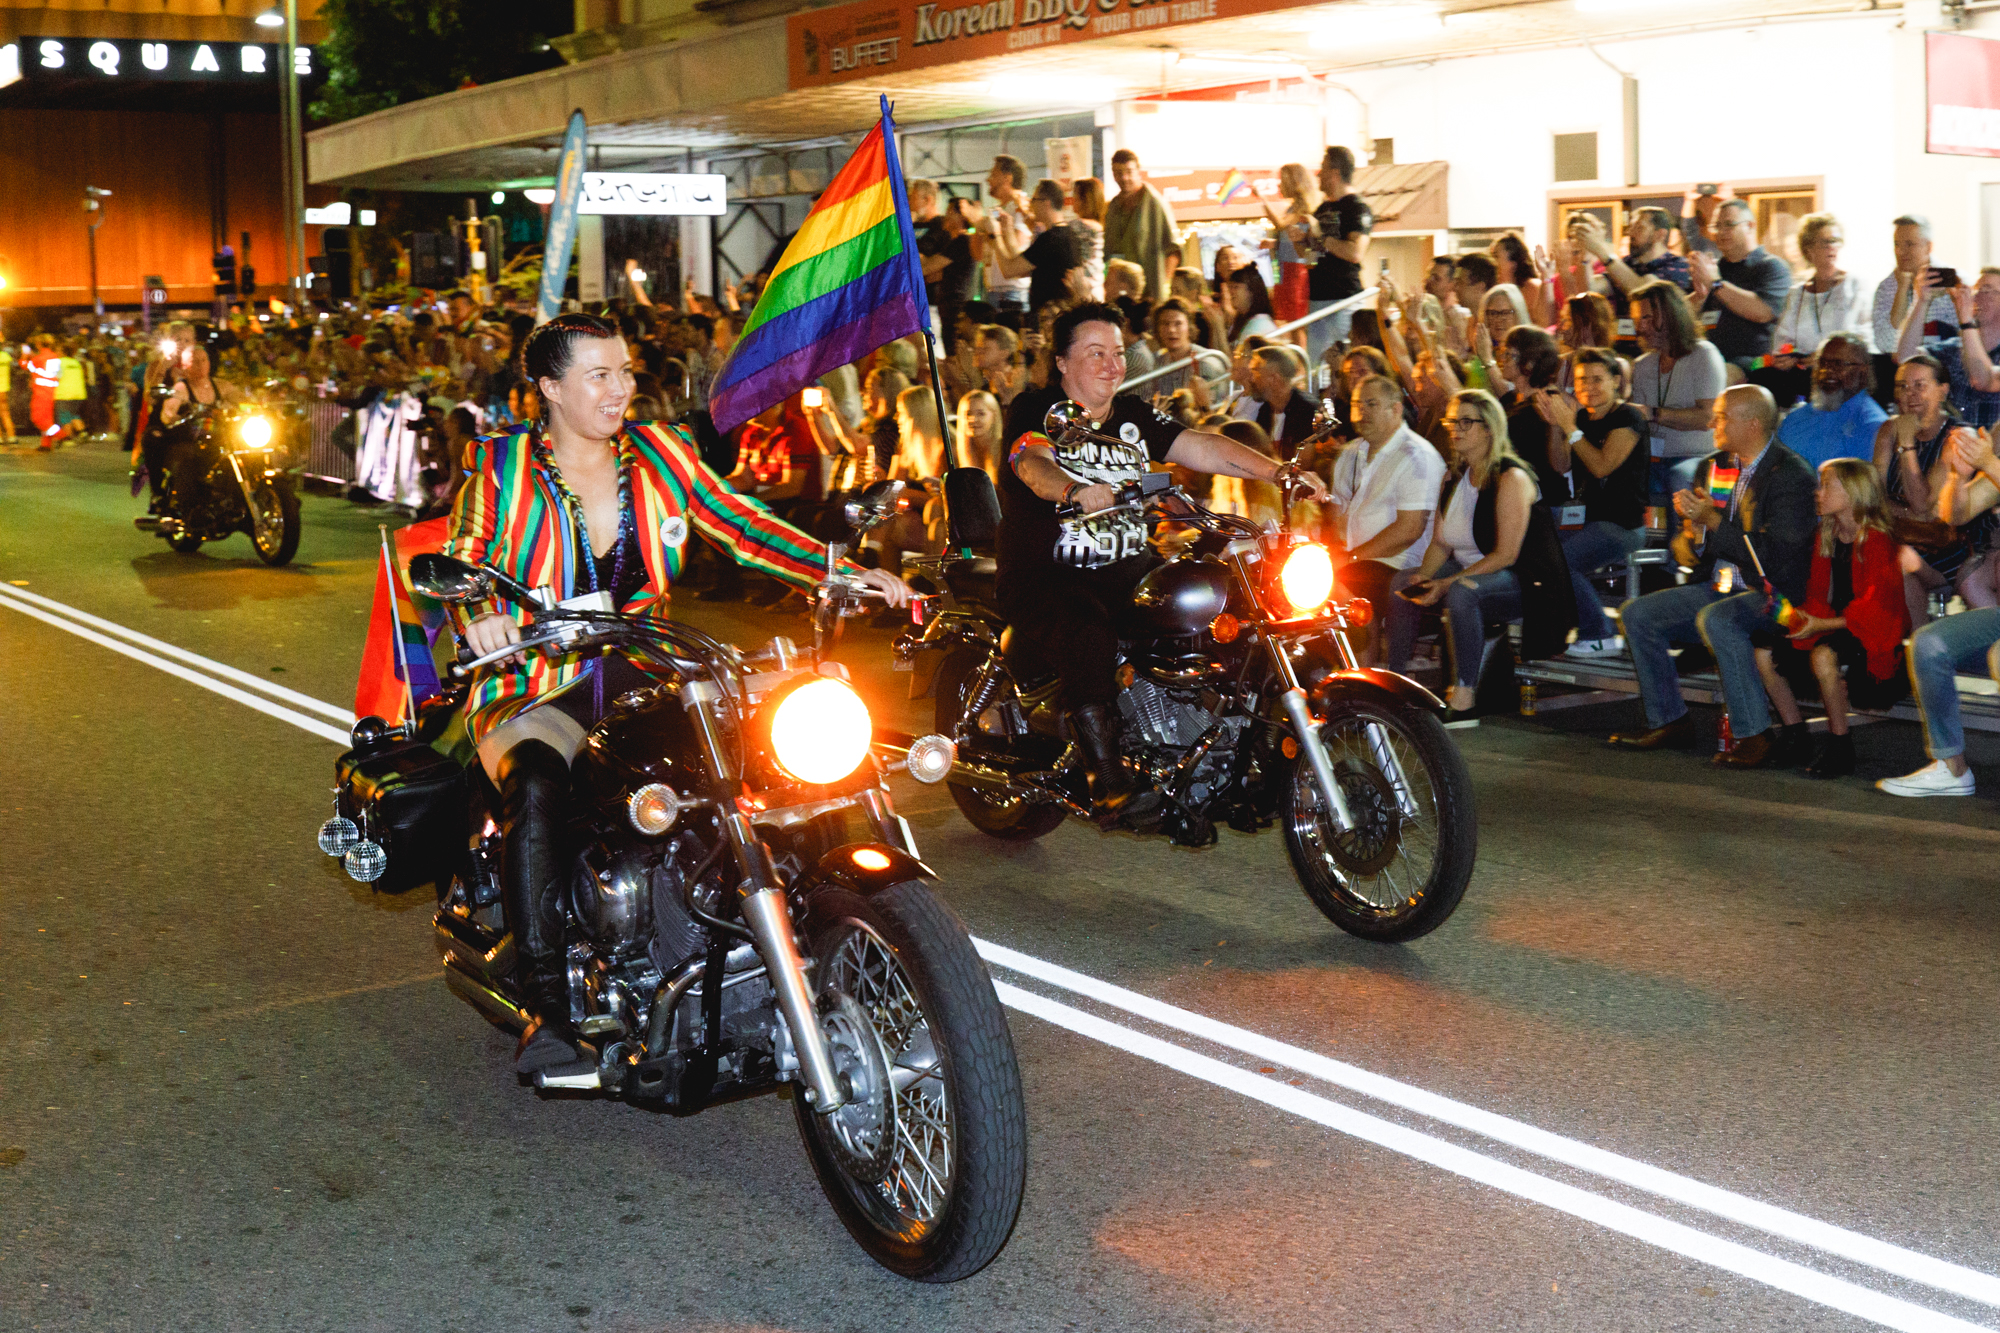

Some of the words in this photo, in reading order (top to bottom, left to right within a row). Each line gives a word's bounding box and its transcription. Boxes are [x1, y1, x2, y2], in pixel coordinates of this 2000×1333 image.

[914, 0, 1016, 44] Korean
[1092, 12, 1132, 34] YOUR
[1133, 6, 1169, 28] OWN
[1171, 0, 1217, 22] TABLE
[39, 39, 312, 75] SQUARE
[830, 36, 902, 72] BUFFET
